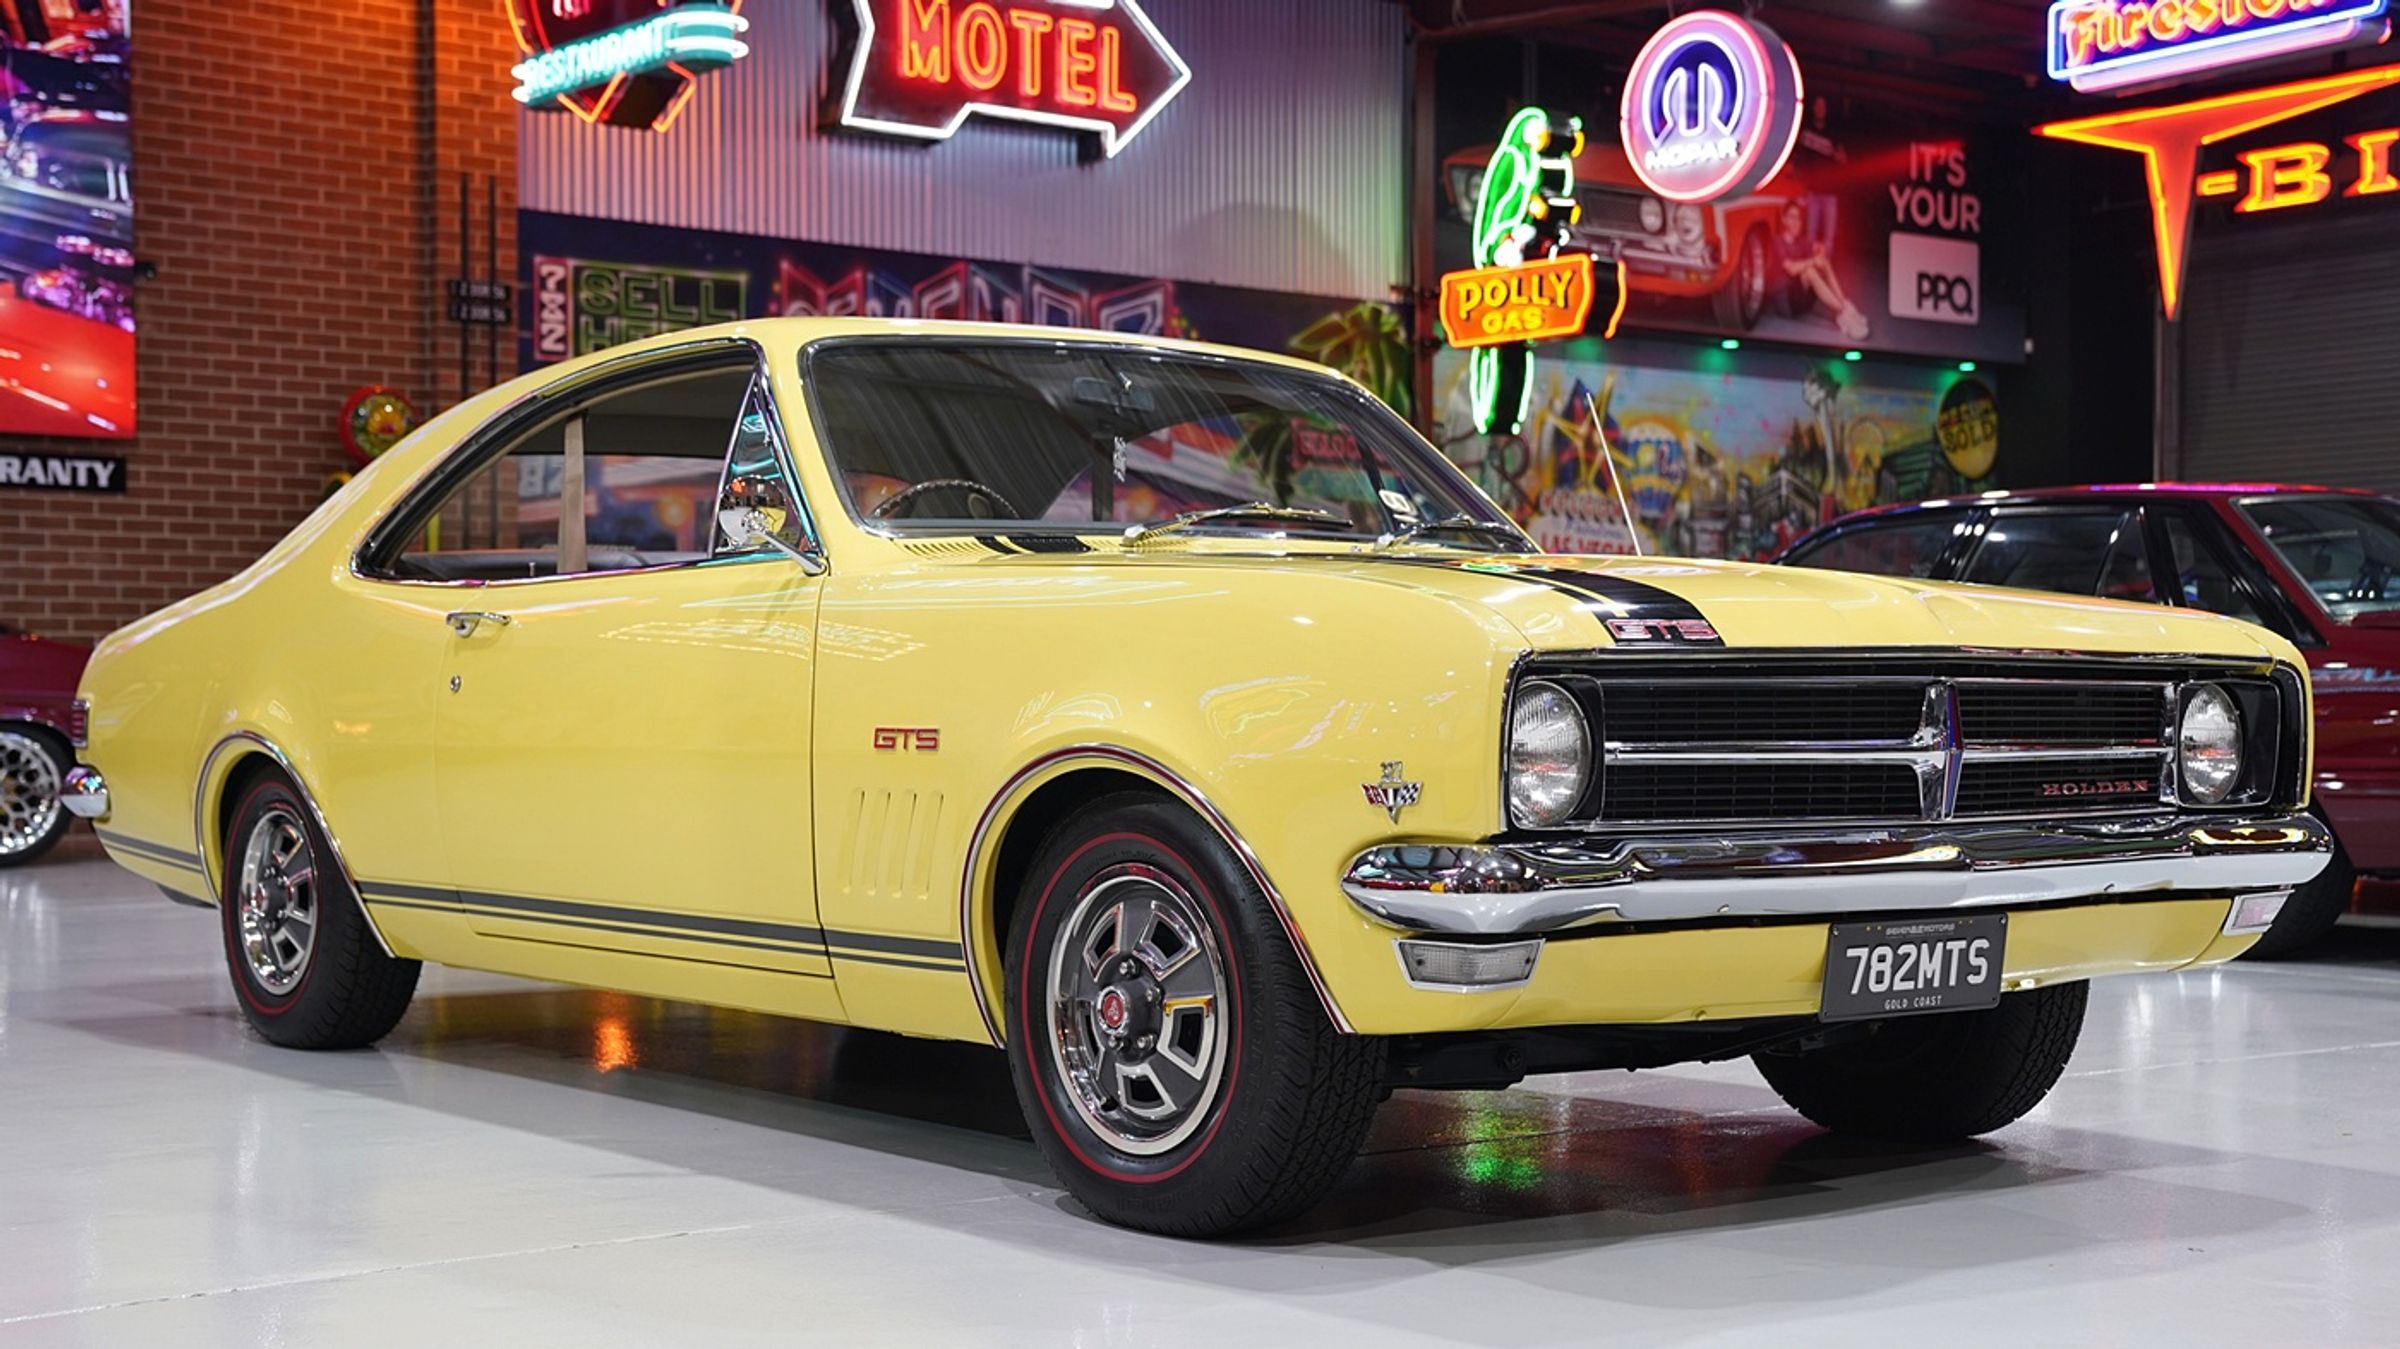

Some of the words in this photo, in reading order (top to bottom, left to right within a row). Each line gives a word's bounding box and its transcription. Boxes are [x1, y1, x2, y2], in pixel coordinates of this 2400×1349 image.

[524, 16, 671, 92] RESTAURANT
[901, 0, 1137, 113] MOTEL
[2058, 0, 2336, 68] Firest
[1644, 137, 1741, 170] MOPAR
[1909, 142, 1967, 188] IT'S
[1888, 183, 1981, 234] YOUR
[578, 269, 740, 324] SELL
[1456, 269, 1573, 320] POLLY
[1916, 271, 1974, 317] PPQ
[1482, 306, 1543, 334] GAS
[0, 455, 115, 488] RANTY
[1605, 618, 1719, 640] GTS
[874, 727, 940, 752] GTS
[2042, 780, 2149, 796] HOLDEN
[1846, 937, 1991, 996] 782MTS
[1884, 998, 1909, 1011] GOLD
[1913, 995, 1943, 1008] COAST
